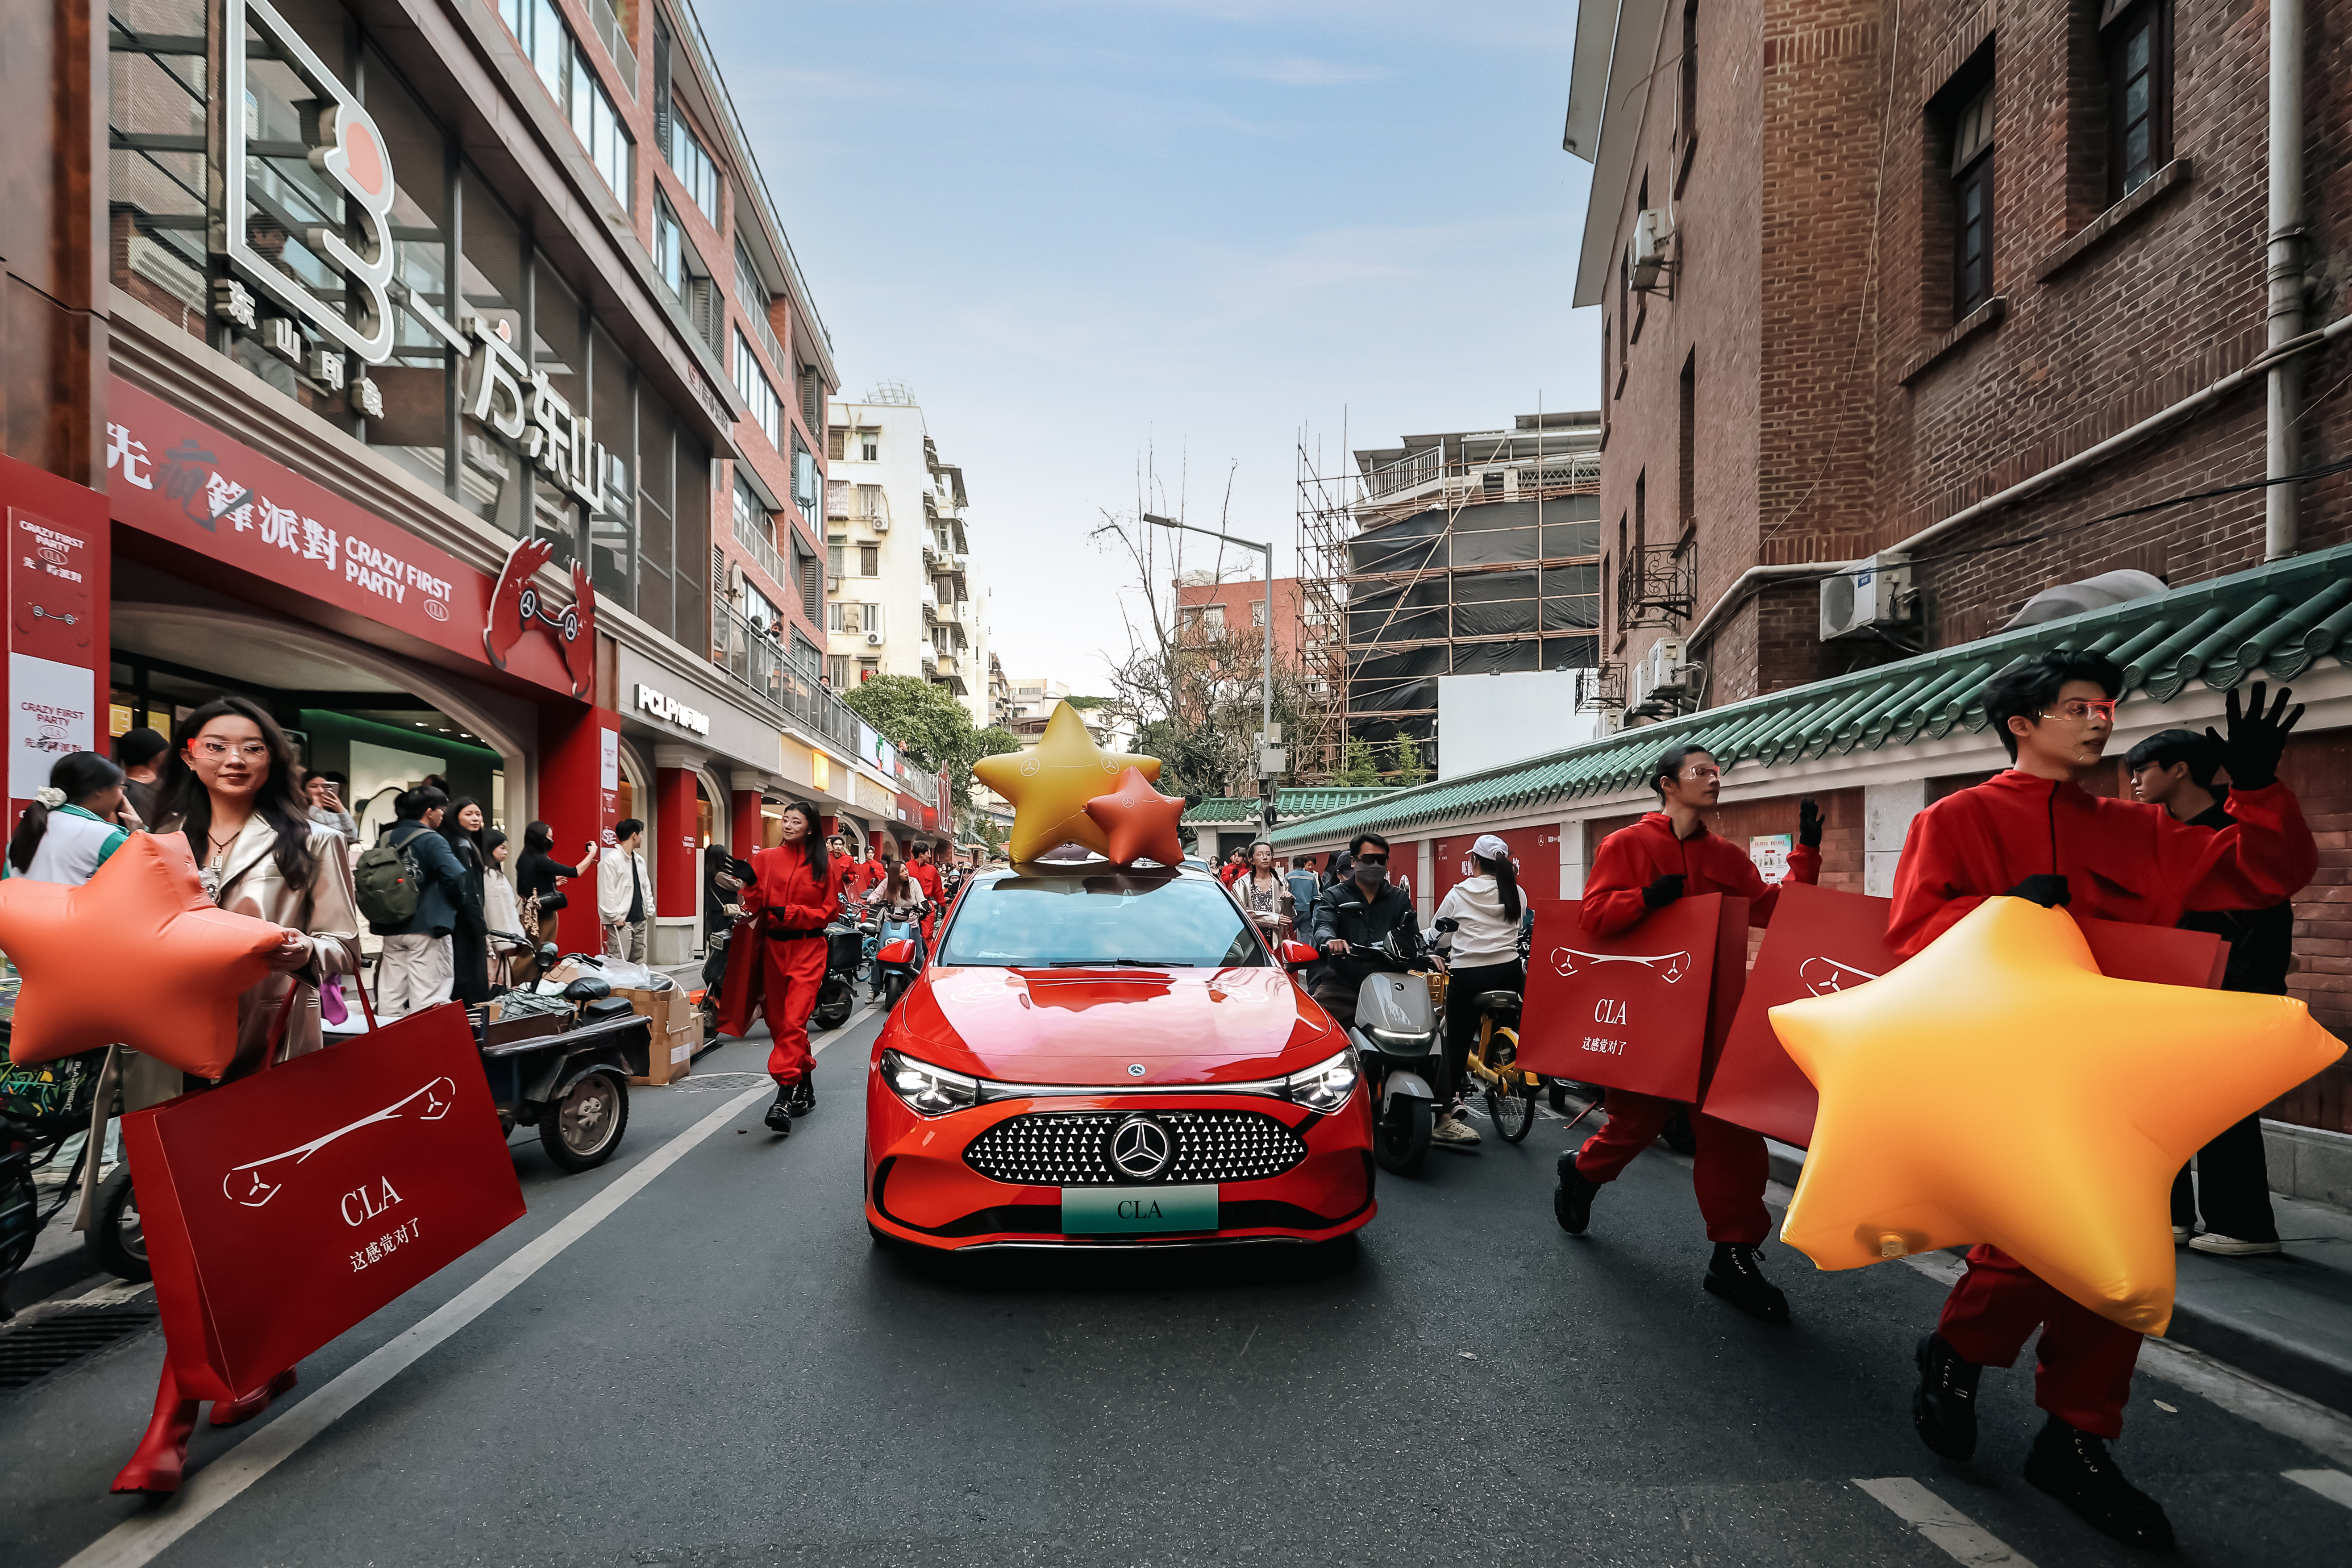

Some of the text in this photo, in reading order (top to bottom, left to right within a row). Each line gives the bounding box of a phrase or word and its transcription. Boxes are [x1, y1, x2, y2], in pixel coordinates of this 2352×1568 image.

[227, 279, 384, 420] 东山印象
[410, 288, 606, 514] 一方东山
[19, 520, 85, 549] CRAZY FIRST
[35, 534, 70, 553] PARTY
[345, 535, 453, 602] CRAZY FIRST
[345, 558, 406, 604] PARTY
[21, 702, 85, 720] CRAZY FIRST
[37, 713, 71, 726] PARTY
[1594, 998, 1627, 1026] CLA
[1581, 1036, 1627, 1056] 这感觉对了
[341, 1176, 403, 1227] CLA
[1117, 1200, 1163, 1219] CLA
[349, 1217, 420, 1273] 这感觉对了
